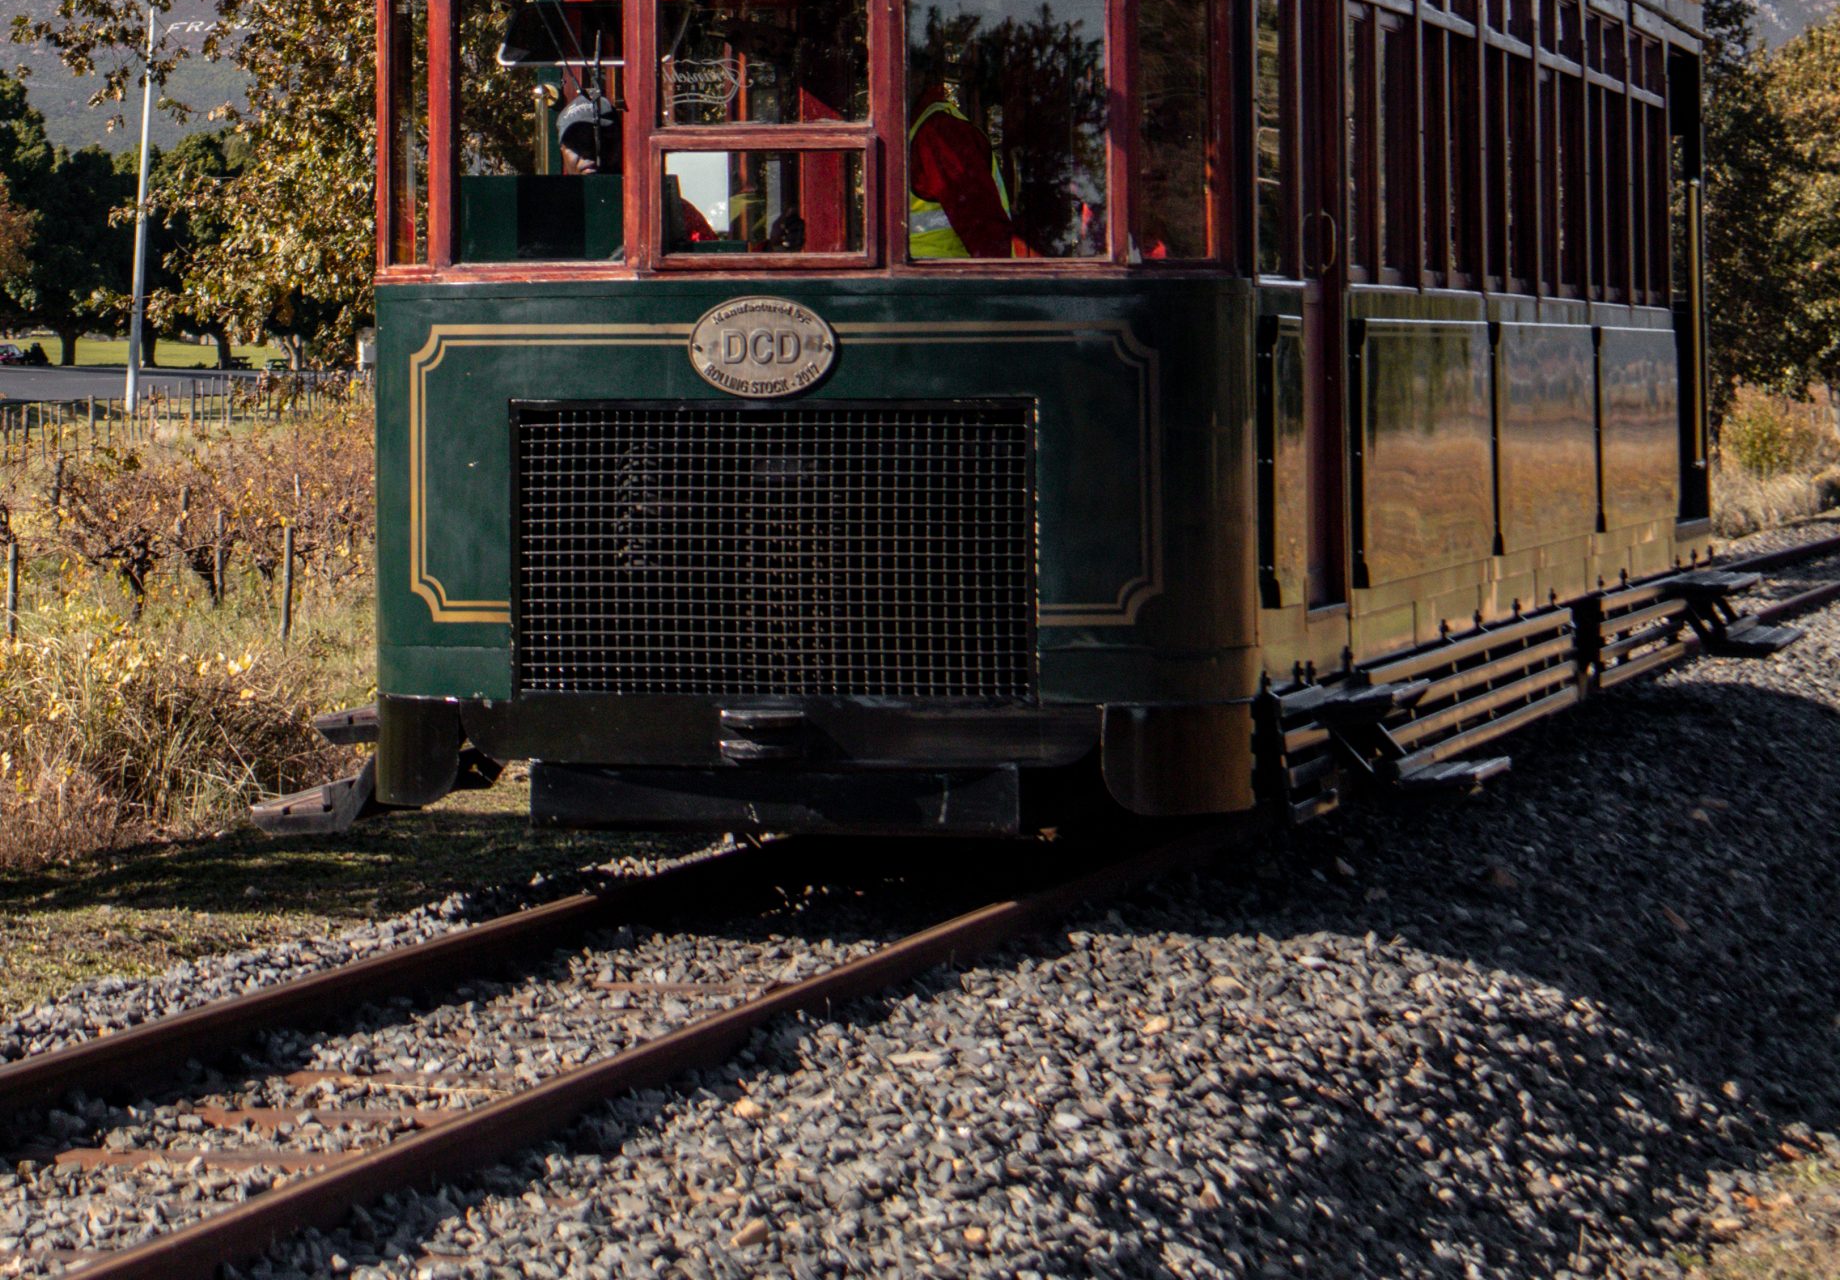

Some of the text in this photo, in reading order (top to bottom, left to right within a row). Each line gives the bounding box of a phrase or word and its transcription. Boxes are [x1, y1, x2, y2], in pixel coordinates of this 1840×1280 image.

[712, 303, 793, 325] Manufactured
[721, 328, 801, 365] DCD
[704, 362, 749, 393] ROLLING
[751, 378, 790, 394] STOCK
[798, 363, 820, 386] 2017
